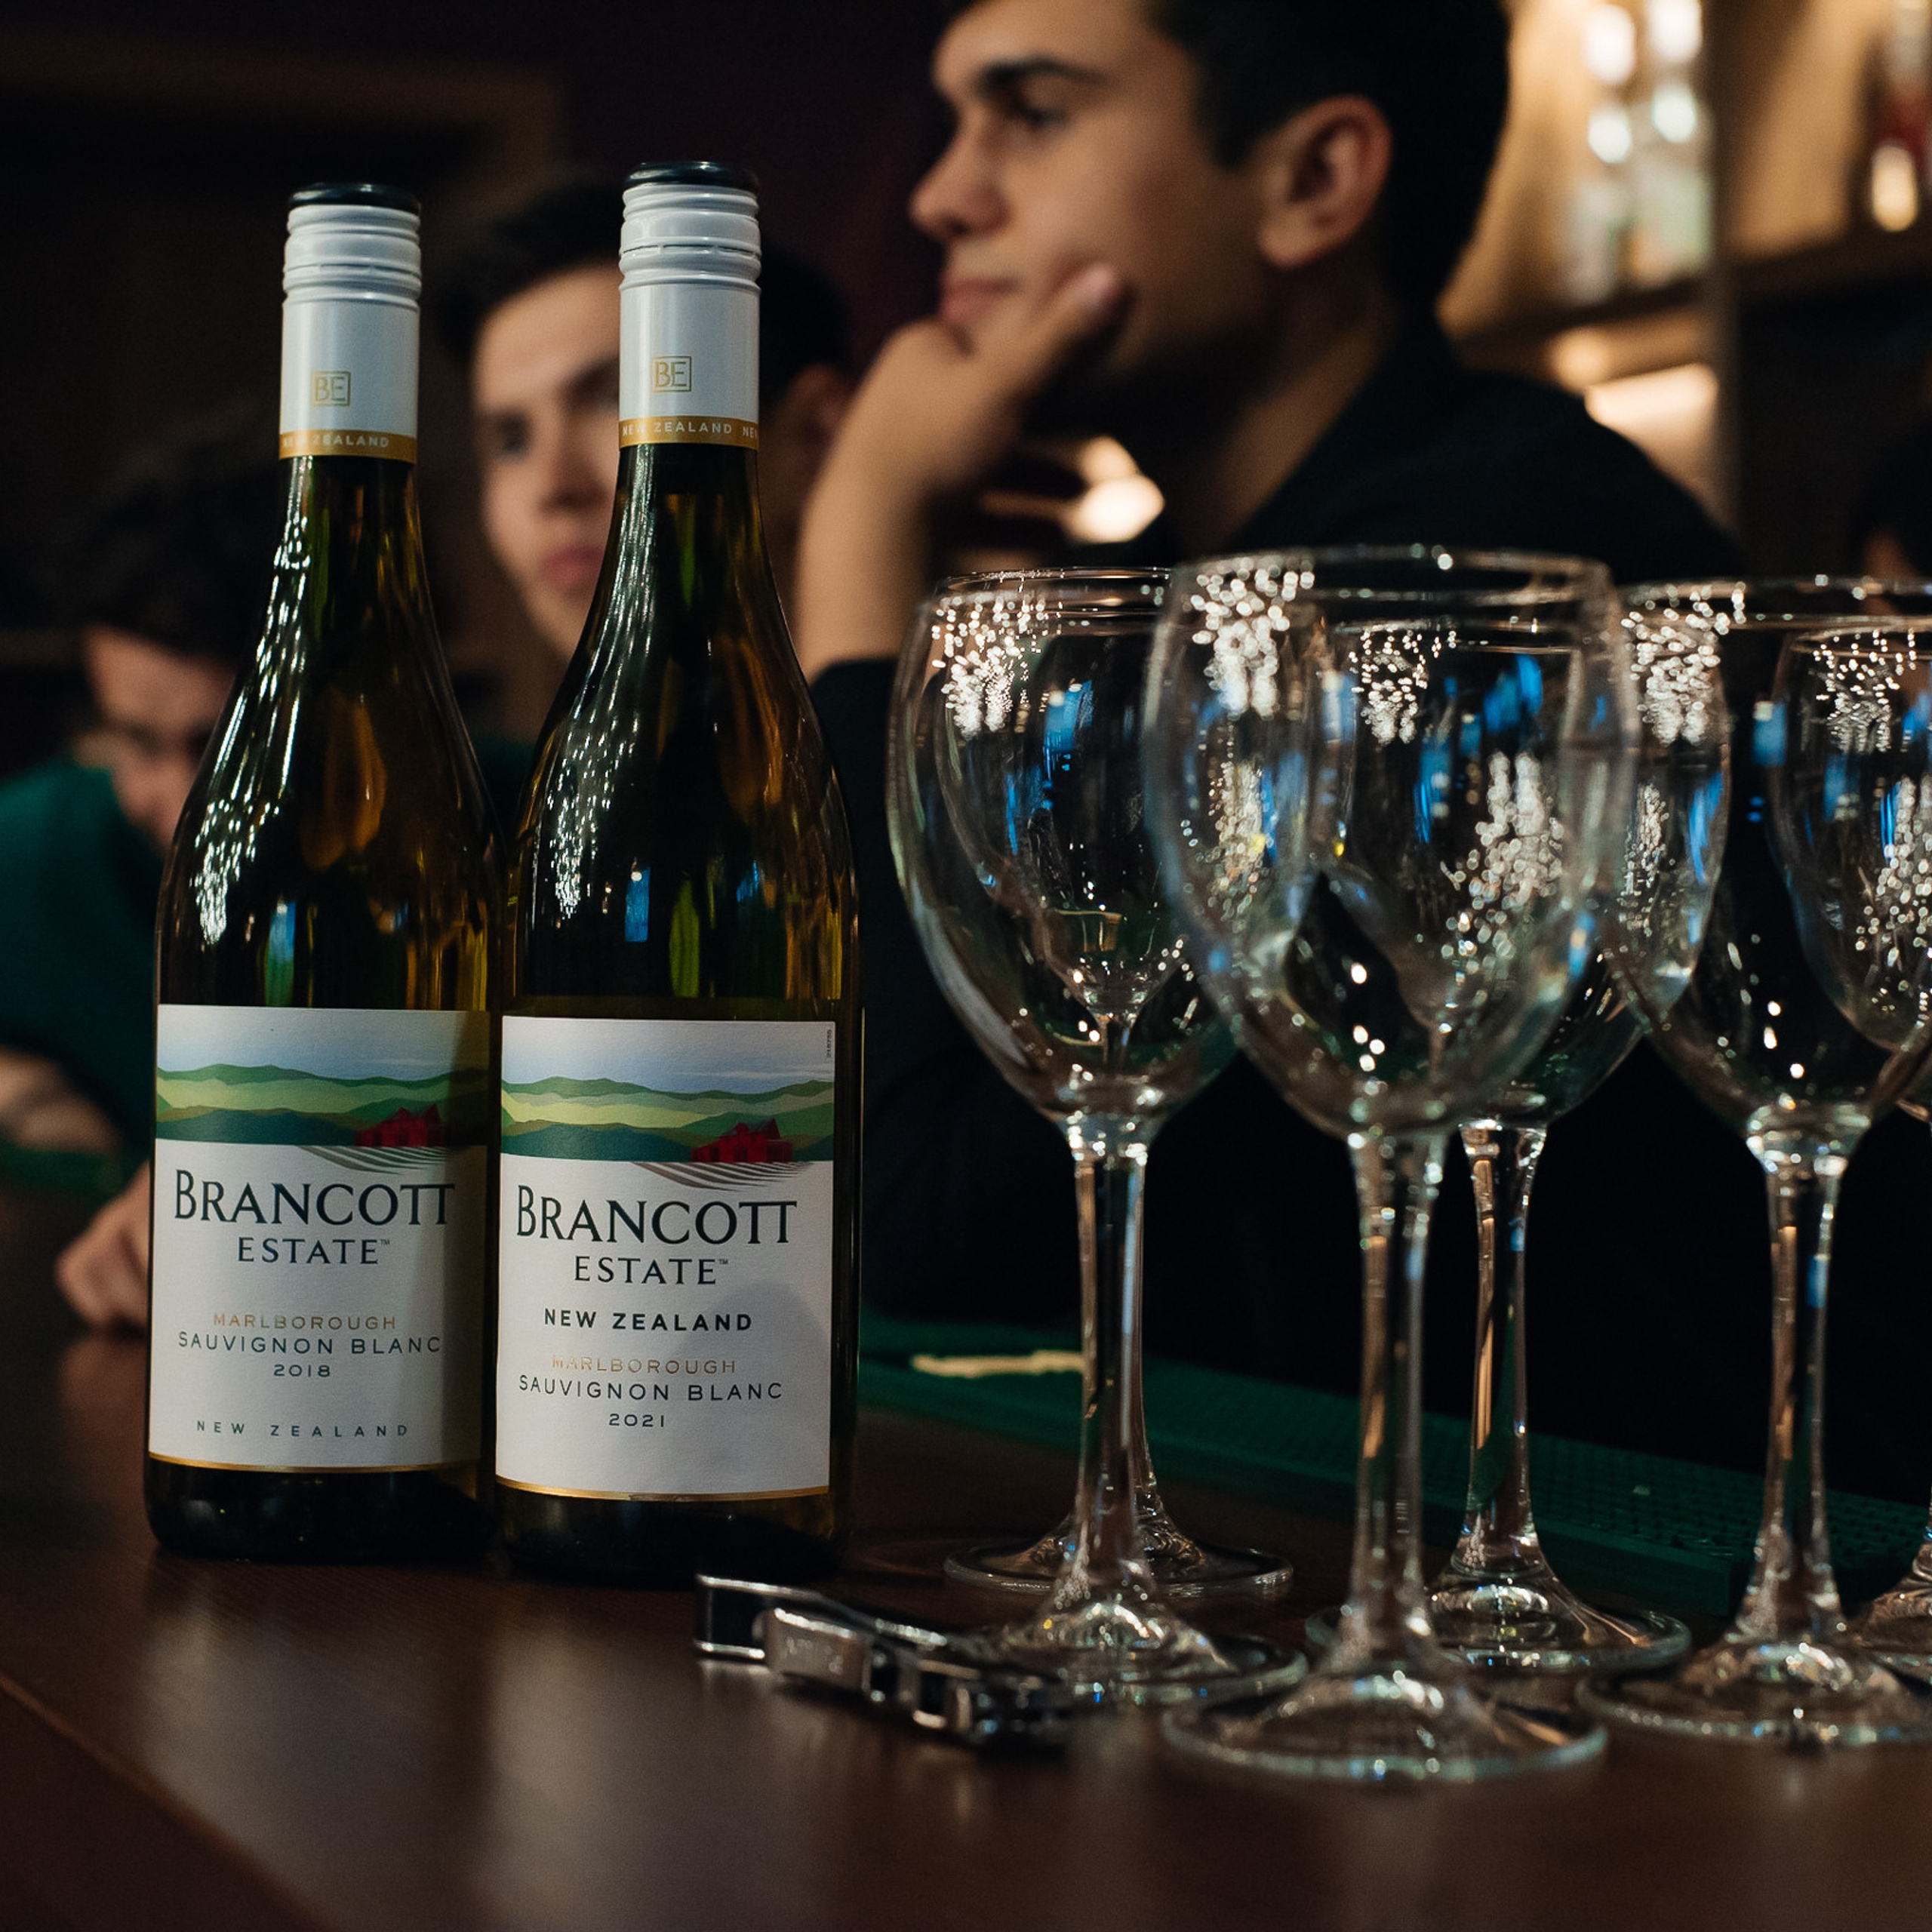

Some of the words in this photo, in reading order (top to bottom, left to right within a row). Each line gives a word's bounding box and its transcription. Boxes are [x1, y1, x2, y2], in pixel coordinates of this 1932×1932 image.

[654, 360, 688, 388] BE
[314, 375, 346, 402] BE
[654, 421, 732, 434] ZEALAND
[312, 434, 389, 448] ZEALAND
[174, 1168, 456, 1226] BRANCOTT
[516, 1184, 798, 1244] BRANCOTT
[214, 1312, 396, 1331] MARLBOROUGH
[544, 1308, 597, 1328] NEW
[612, 1312, 752, 1332] ZEALAND
[178, 1331, 334, 1355] SAUVIGNON
[351, 1335, 441, 1355] BLANC
[273, 1363, 331, 1378] 2018
[552, 1354, 736, 1375] MARLBOROUGH
[518, 1374, 669, 1401] SAUVIGNON
[688, 1383, 783, 1401] BLANC
[196, 1420, 246, 1435] NEW
[270, 1423, 408, 1438] ZEALAND
[608, 1413, 665, 1429] 2021
